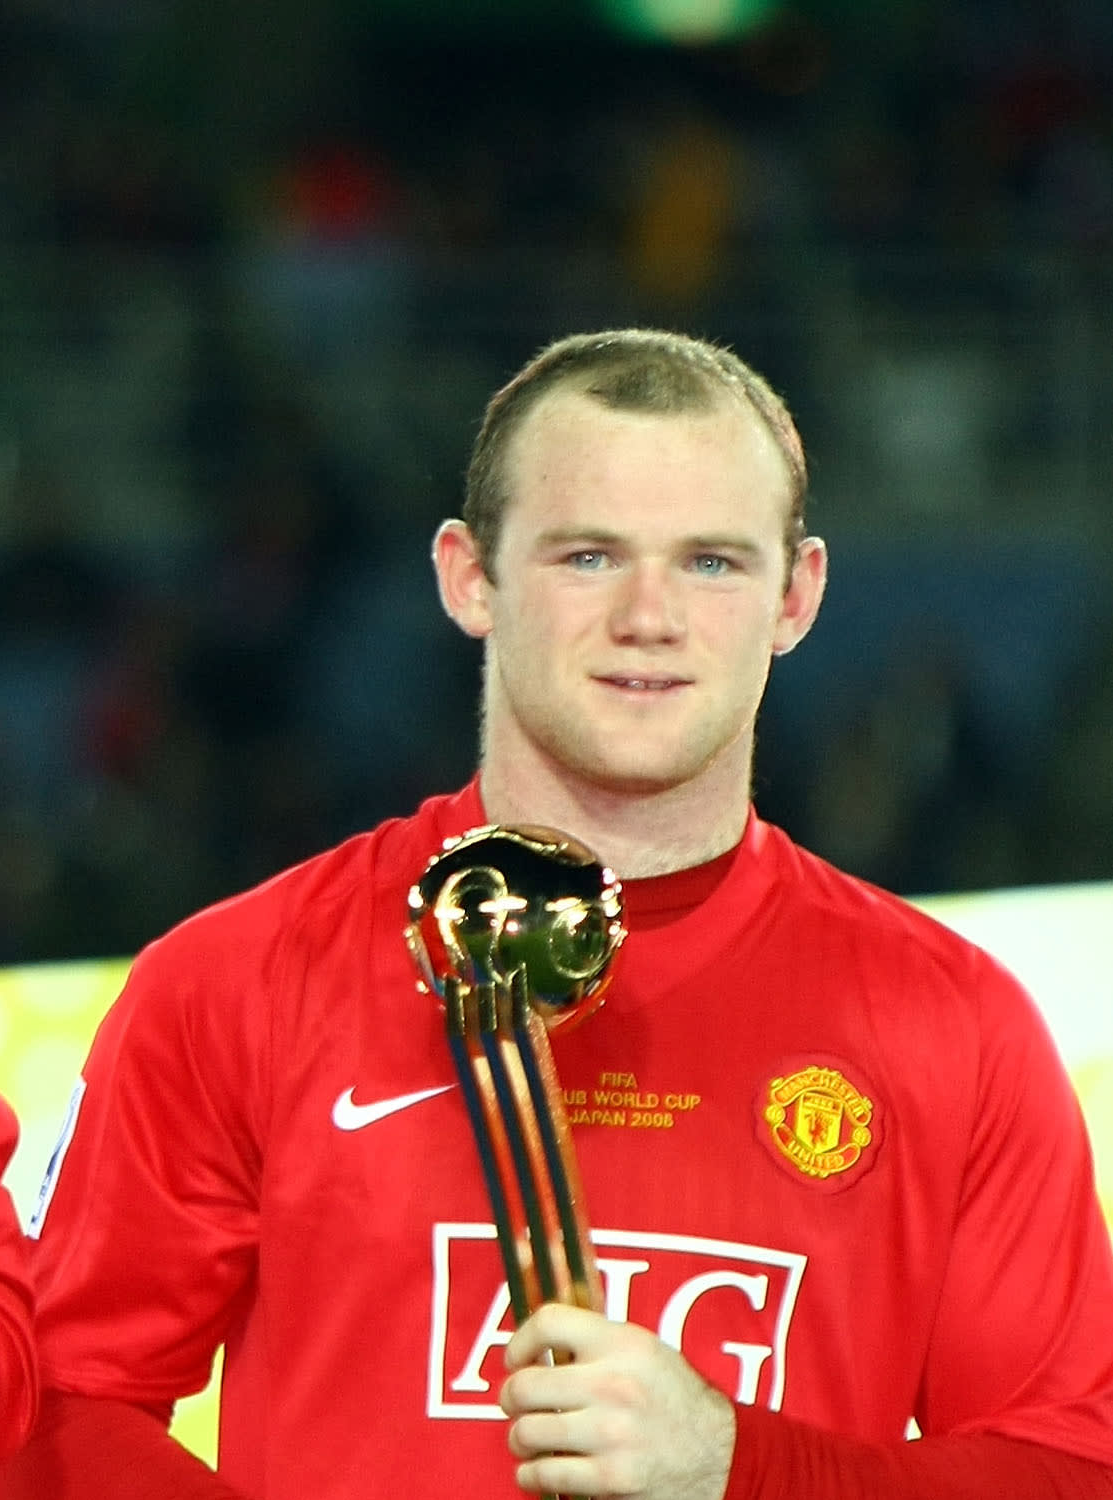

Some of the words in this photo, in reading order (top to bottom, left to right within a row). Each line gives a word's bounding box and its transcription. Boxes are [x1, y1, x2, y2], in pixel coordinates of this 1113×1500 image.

[601, 1072, 637, 1088] FIFA
[563, 1089, 587, 1105] UB
[594, 1090, 659, 1109] WORLD
[665, 1093, 702, 1110] CUP
[778, 1073, 865, 1118] MANCHESTER
[569, 1109, 626, 1126] JAPAN
[631, 1112, 674, 1128] 2008
[787, 1140, 845, 1168] UNITED
